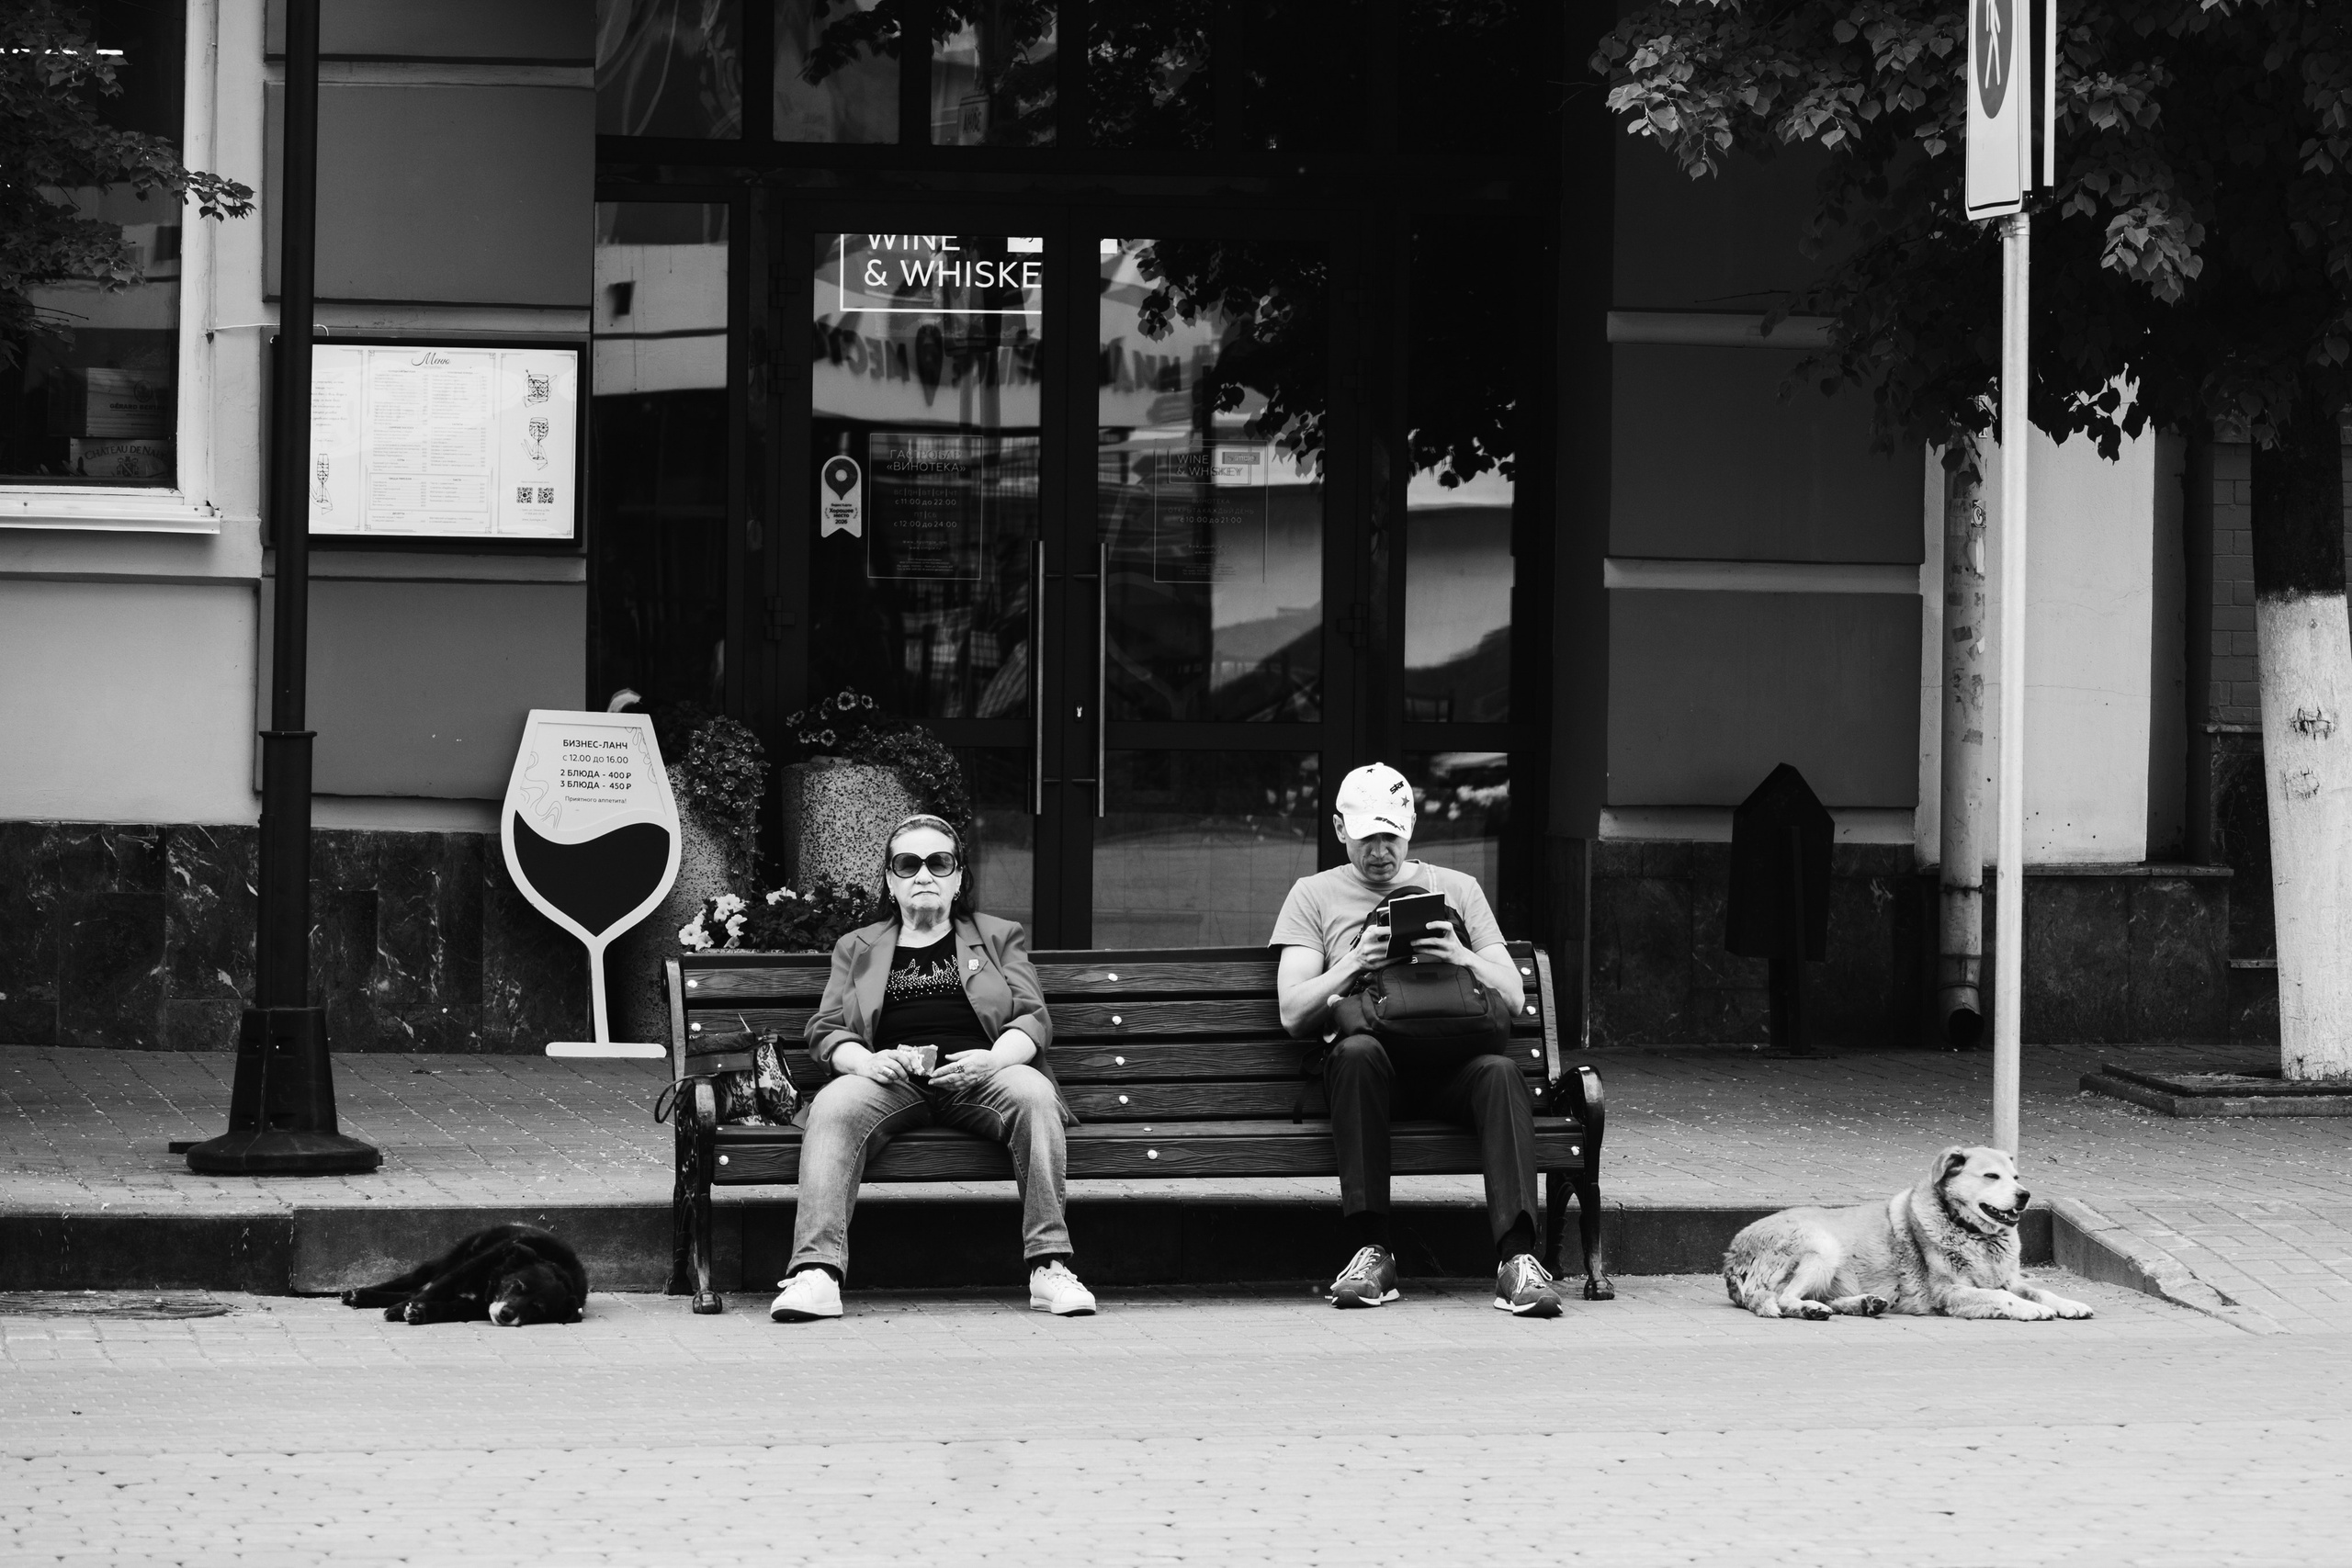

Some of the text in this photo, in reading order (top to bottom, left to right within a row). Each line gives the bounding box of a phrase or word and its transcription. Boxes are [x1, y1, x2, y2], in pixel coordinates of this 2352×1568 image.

[868, 235, 960, 251] WINE
[864, 259, 1042, 288] & WHISKE
[412, 352, 449, 367] Меню
[109, 402, 138, 411] GÉRARD
[130, 446, 141, 455] DE
[889, 449, 963, 460] ГАСТРОБАР
[1176, 455, 1209, 464] WINE
[887, 461, 967, 472] «ВИНОТЕКА»
[1176, 466, 1244, 477] & WHSKEY
[1167, 506, 1202, 514] ОТКРЫТА
[563, 739, 628, 750] БИЗНЕС-ЛАНЧ
[569, 753, 592, 762] 12.00
[606, 755, 628, 764] 16.00
[567, 769, 600, 779] БЛЮДА
[567, 780, 600, 790] БЛЮДА
